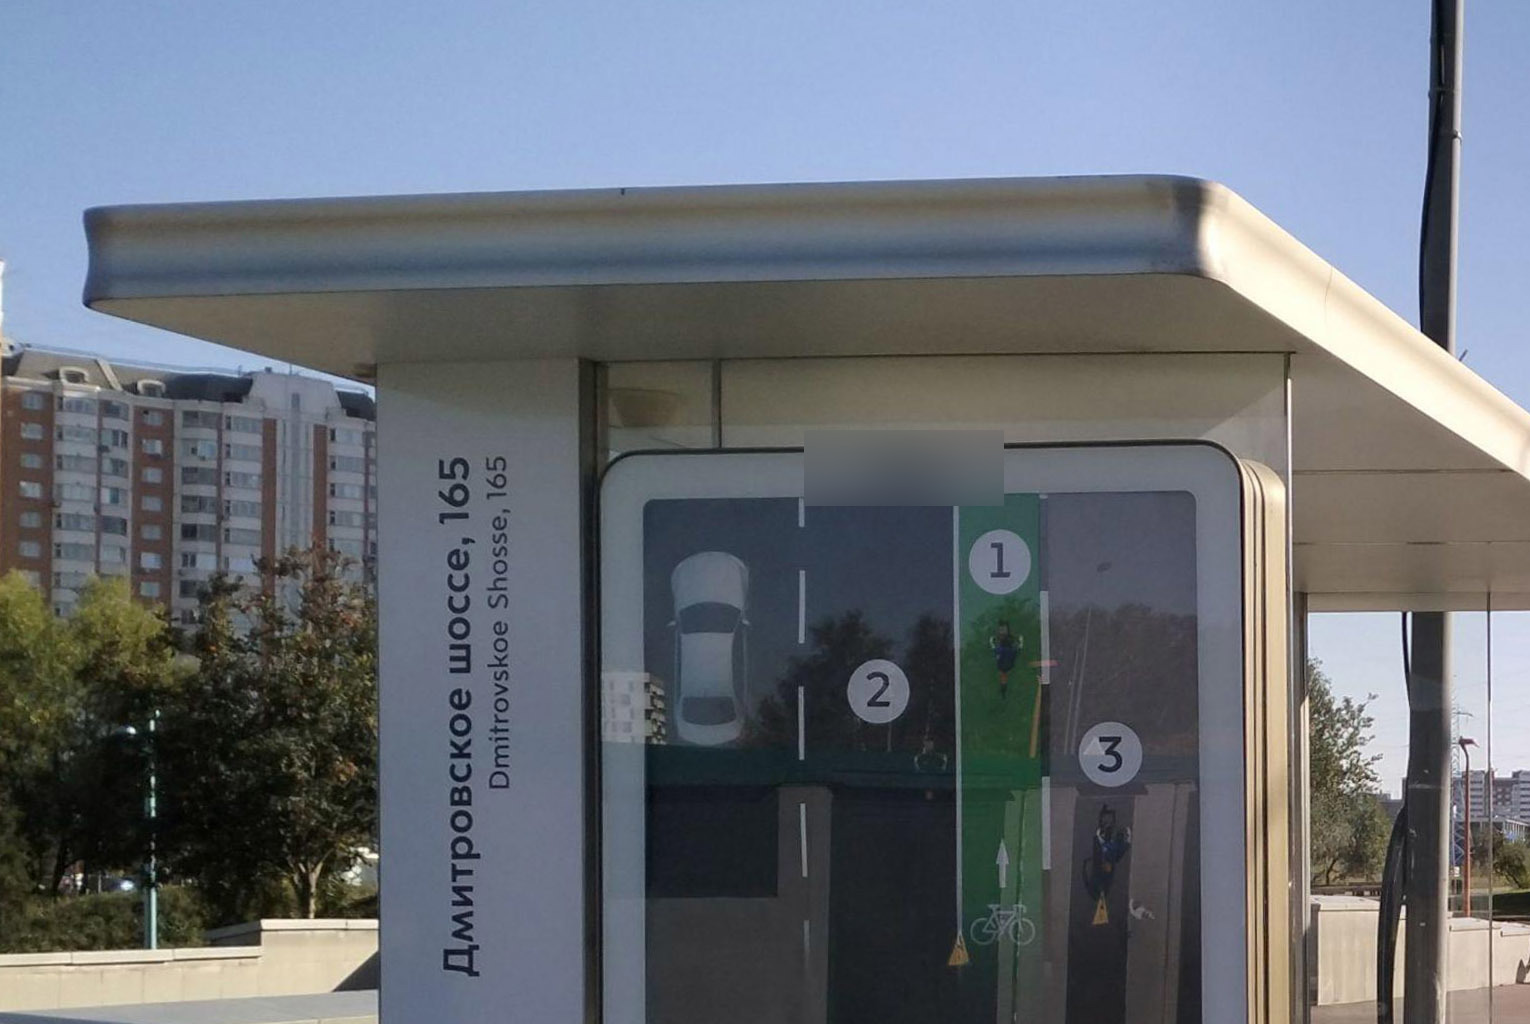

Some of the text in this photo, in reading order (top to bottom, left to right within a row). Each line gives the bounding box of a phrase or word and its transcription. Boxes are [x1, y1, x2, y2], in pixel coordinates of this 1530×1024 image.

[989, 542, 1012, 578] 1
[486, 455, 512, 791] Dmitrovskoe Shosse, 165
[866, 672, 892, 708] 2
[438, 457, 481, 977] Дмитровское шоссе, 165
[1097, 735, 1123, 772] 3
